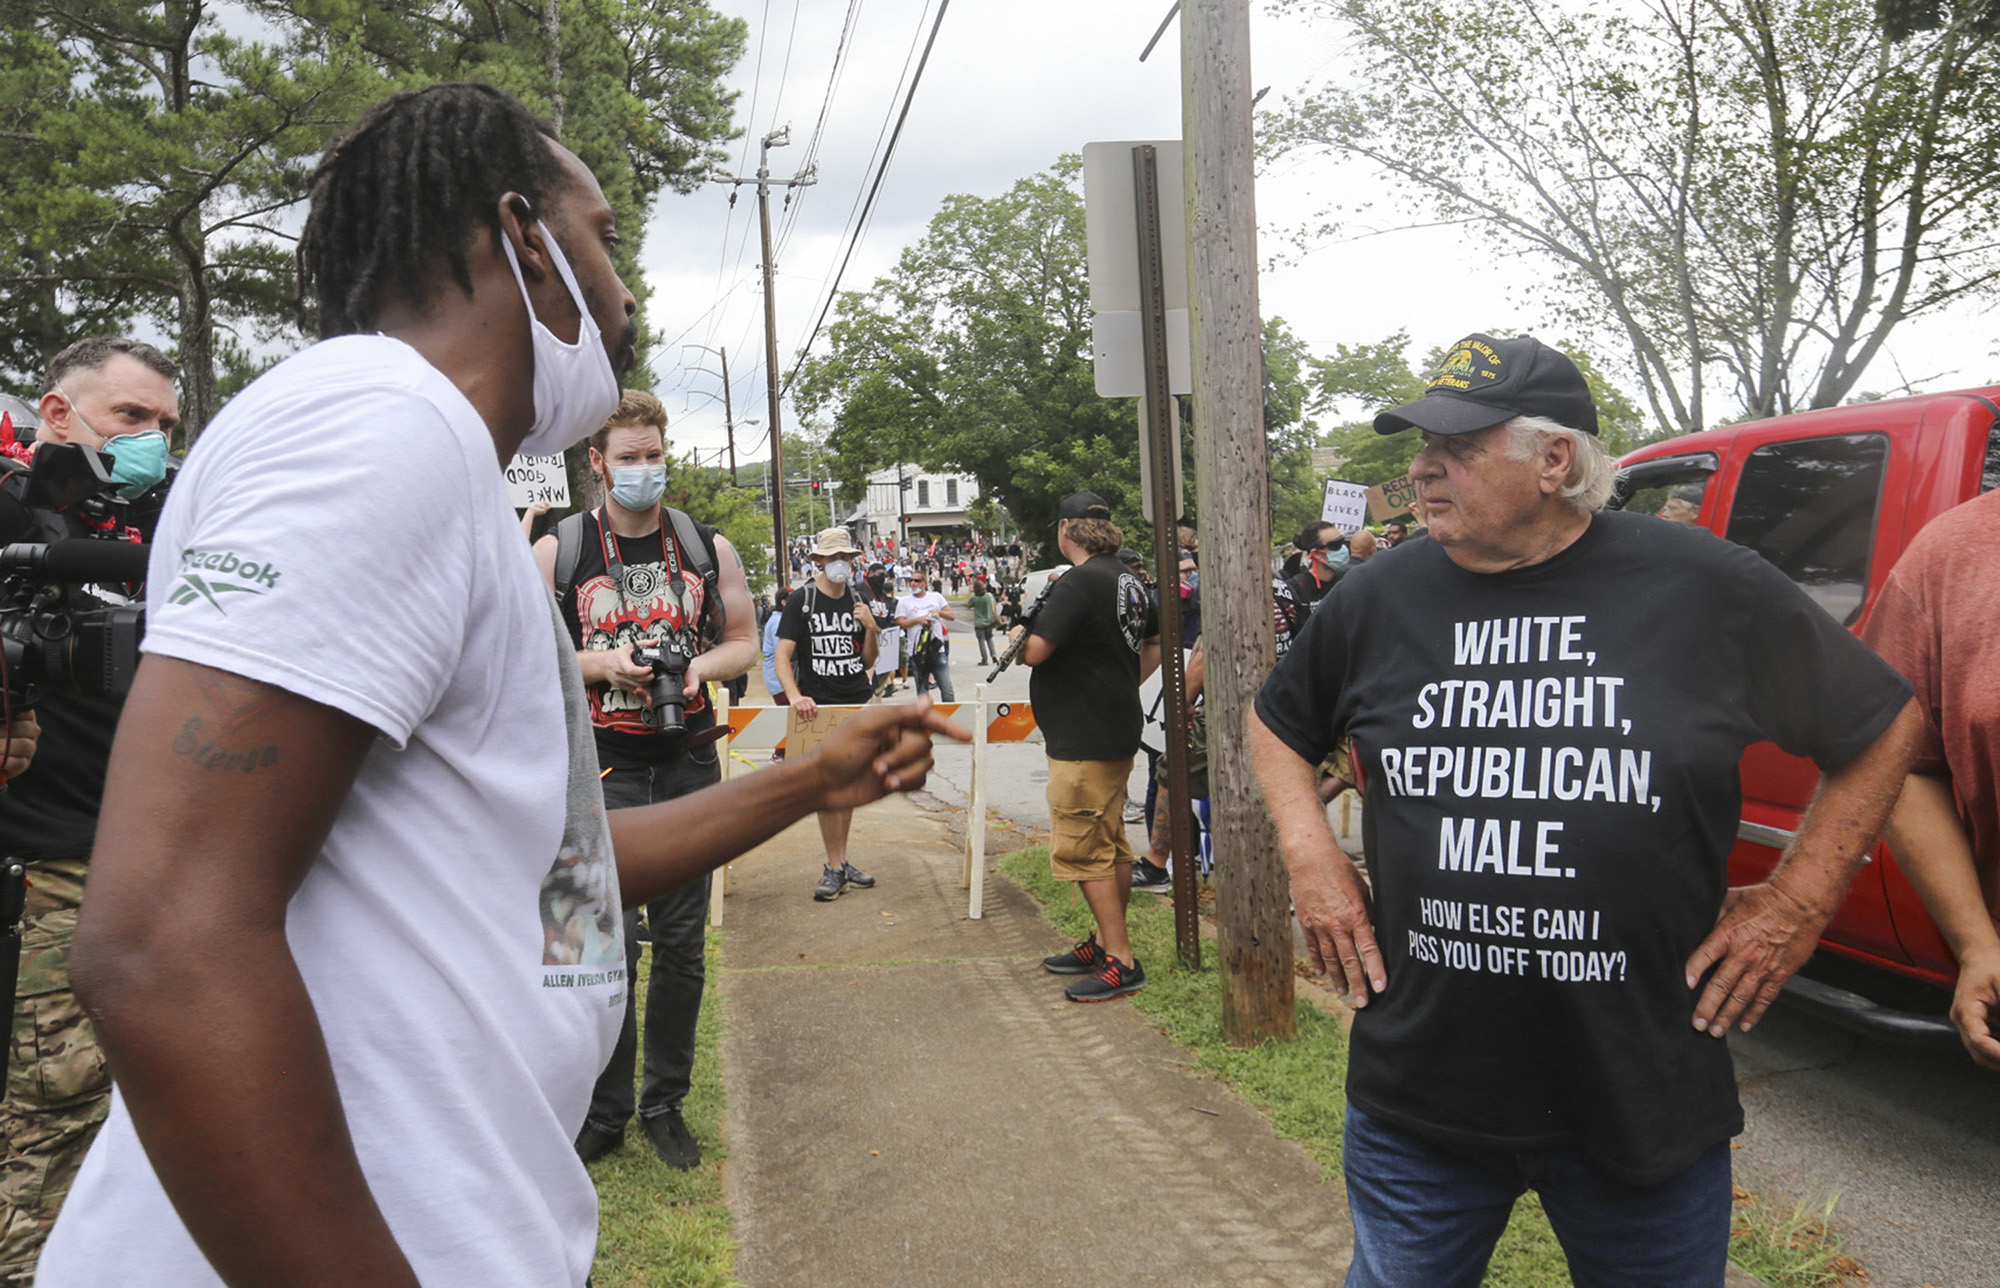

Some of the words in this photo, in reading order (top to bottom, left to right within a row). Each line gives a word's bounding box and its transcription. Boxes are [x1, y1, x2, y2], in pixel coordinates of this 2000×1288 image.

[1472, 340, 1493, 358] VALOR
[1488, 354, 1502, 366] OF
[506, 468, 547, 485] GOOD
[527, 486, 565, 503] MAKE
[1327, 486, 1364, 499] BLACK
[1327, 504, 1360, 517] LIVES
[604, 530, 616, 559] Canon
[182, 548, 282, 588] Reebok
[668, 552, 678, 574] EOS
[812, 637, 852, 654] LIVES
[878, 628, 897, 647] UST
[1454, 615, 1597, 666] WHITE,
[1412, 676, 1632, 736] STRAIGHT,
[1380, 746, 1662, 813] REPUBLICAN,
[1438, 817, 1576, 878] MALE.
[1420, 897, 1462, 931] HOW
[1468, 902, 1525, 938] ELSE
[1533, 908, 1586, 941] CAN
[1592, 910, 1600, 941] I
[1408, 929, 1439, 965] PISS
[1441, 938, 1481, 972] YOU
[1487, 945, 1529, 976] OFF
[1536, 948, 1627, 982] TODAY?
[543, 974, 575, 988] ALLEN
